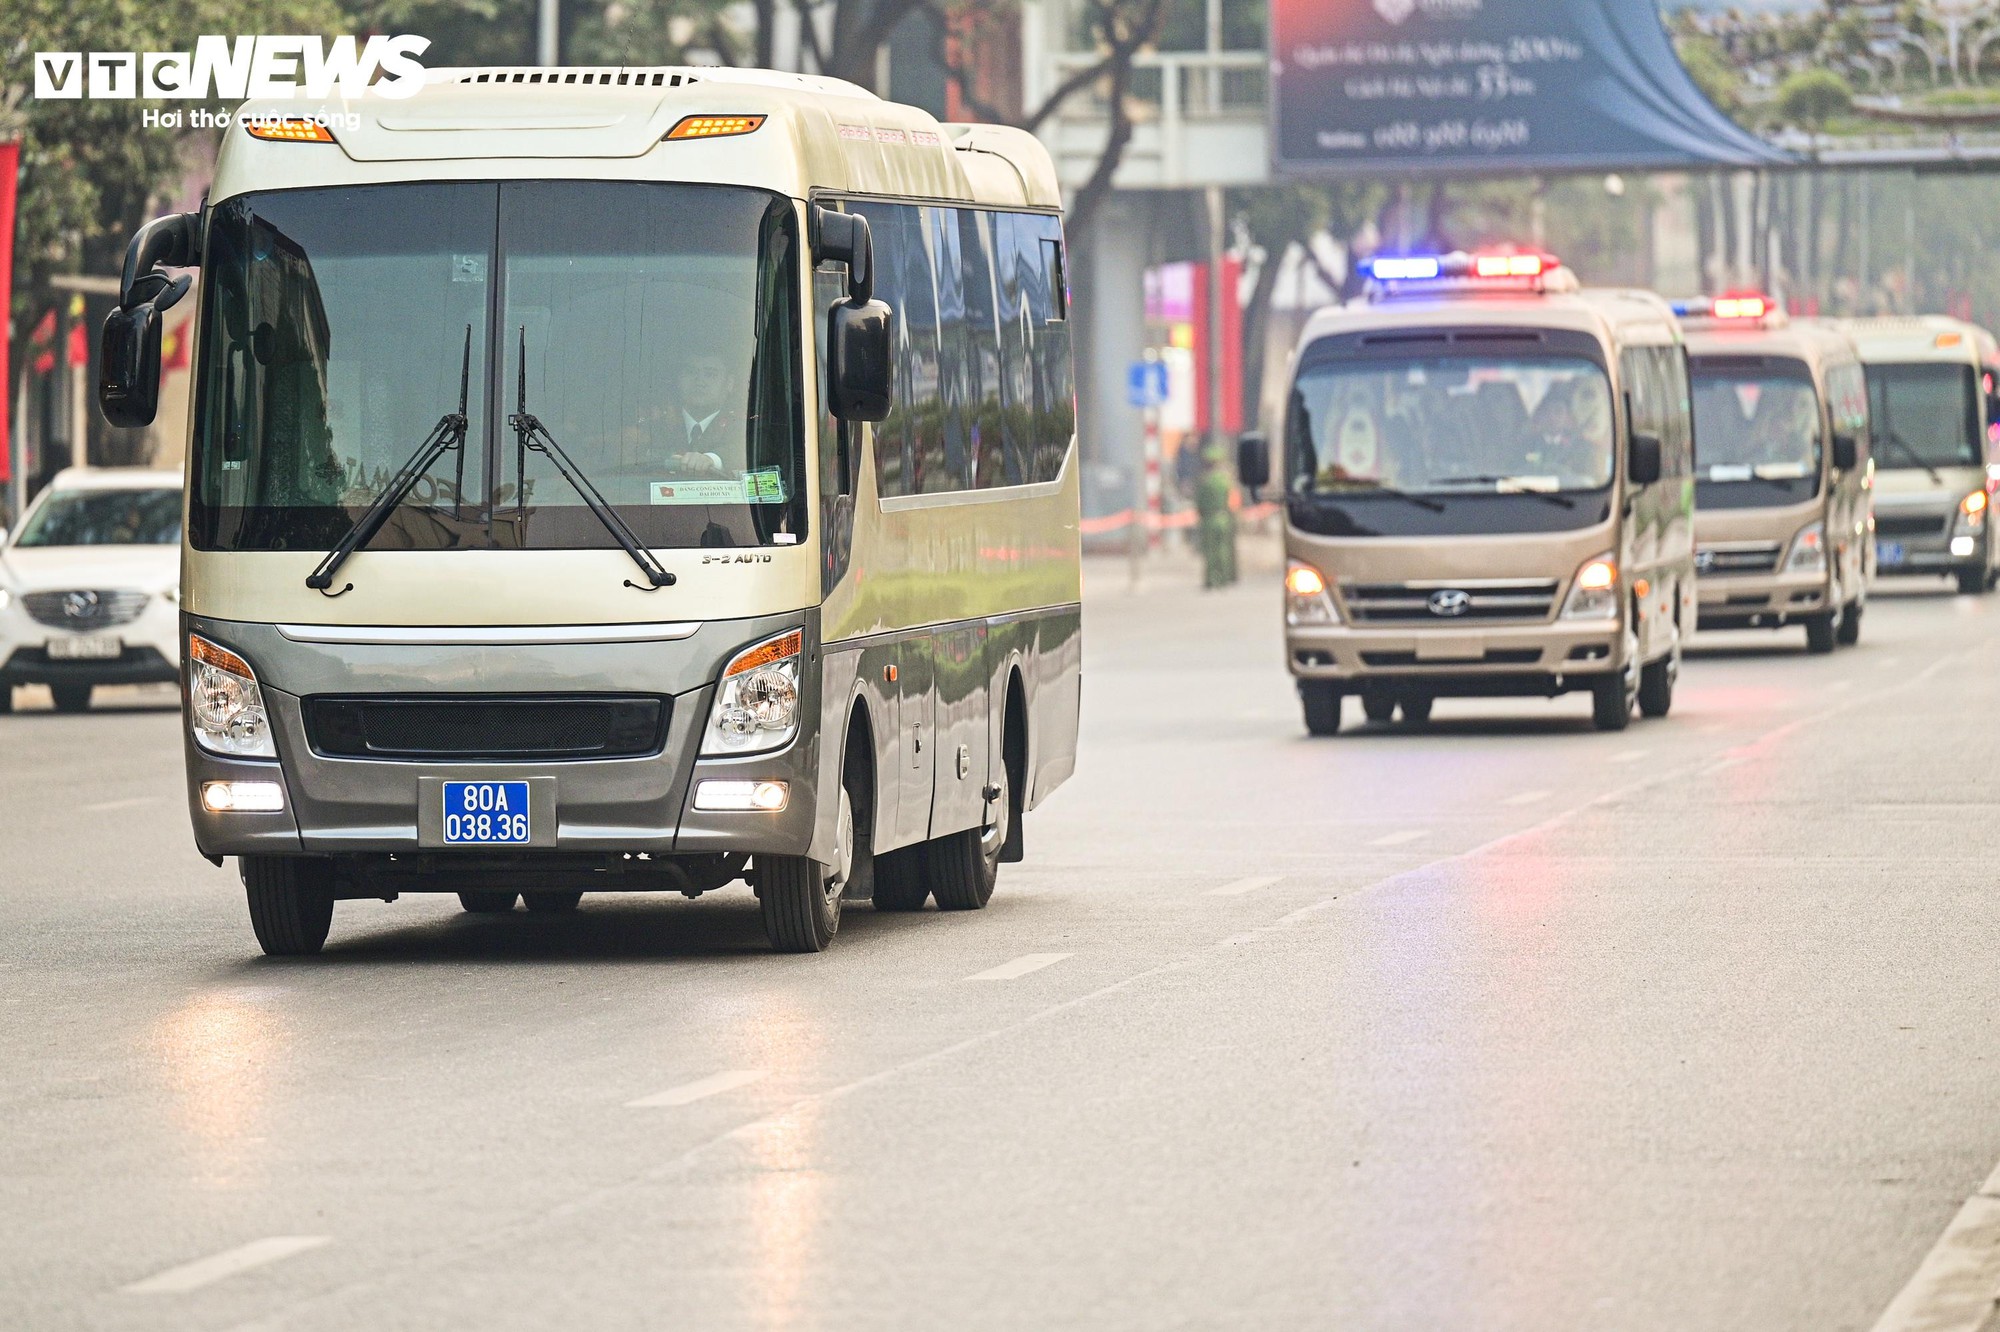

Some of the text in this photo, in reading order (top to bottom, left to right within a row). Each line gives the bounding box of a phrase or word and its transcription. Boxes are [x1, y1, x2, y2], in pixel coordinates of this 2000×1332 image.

[734, 553, 772, 564] AUTO
[463, 784, 509, 812] 80A
[446, 813, 527, 841] 038.36
